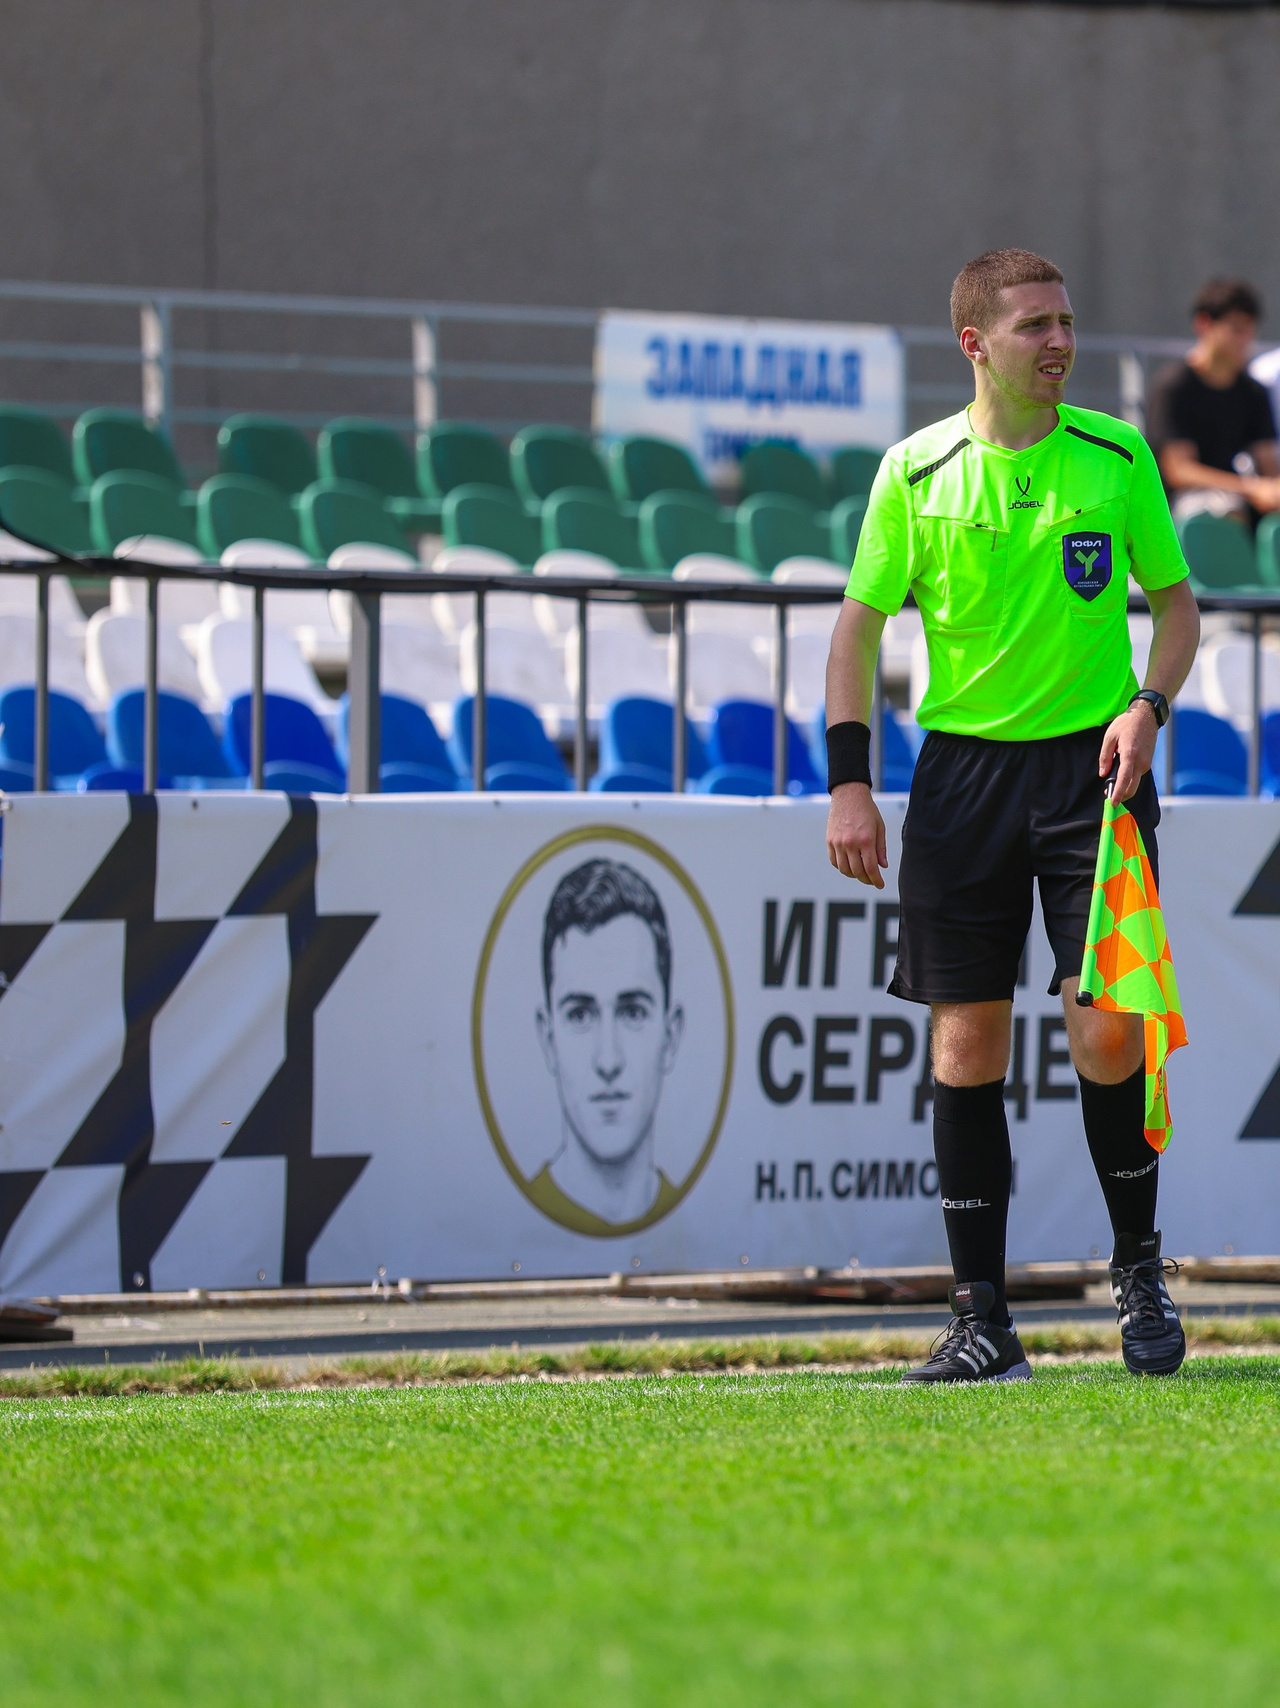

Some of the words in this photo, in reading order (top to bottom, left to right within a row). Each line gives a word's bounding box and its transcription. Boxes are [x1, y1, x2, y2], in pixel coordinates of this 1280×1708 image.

[645, 335, 863, 412] ЗАПАДНАЯ
[1008, 500, 1044, 510] JÖGEL
[1071, 540, 1102, 548] ЮФЛ
[942, 1198, 990, 1209] ÖGEL
